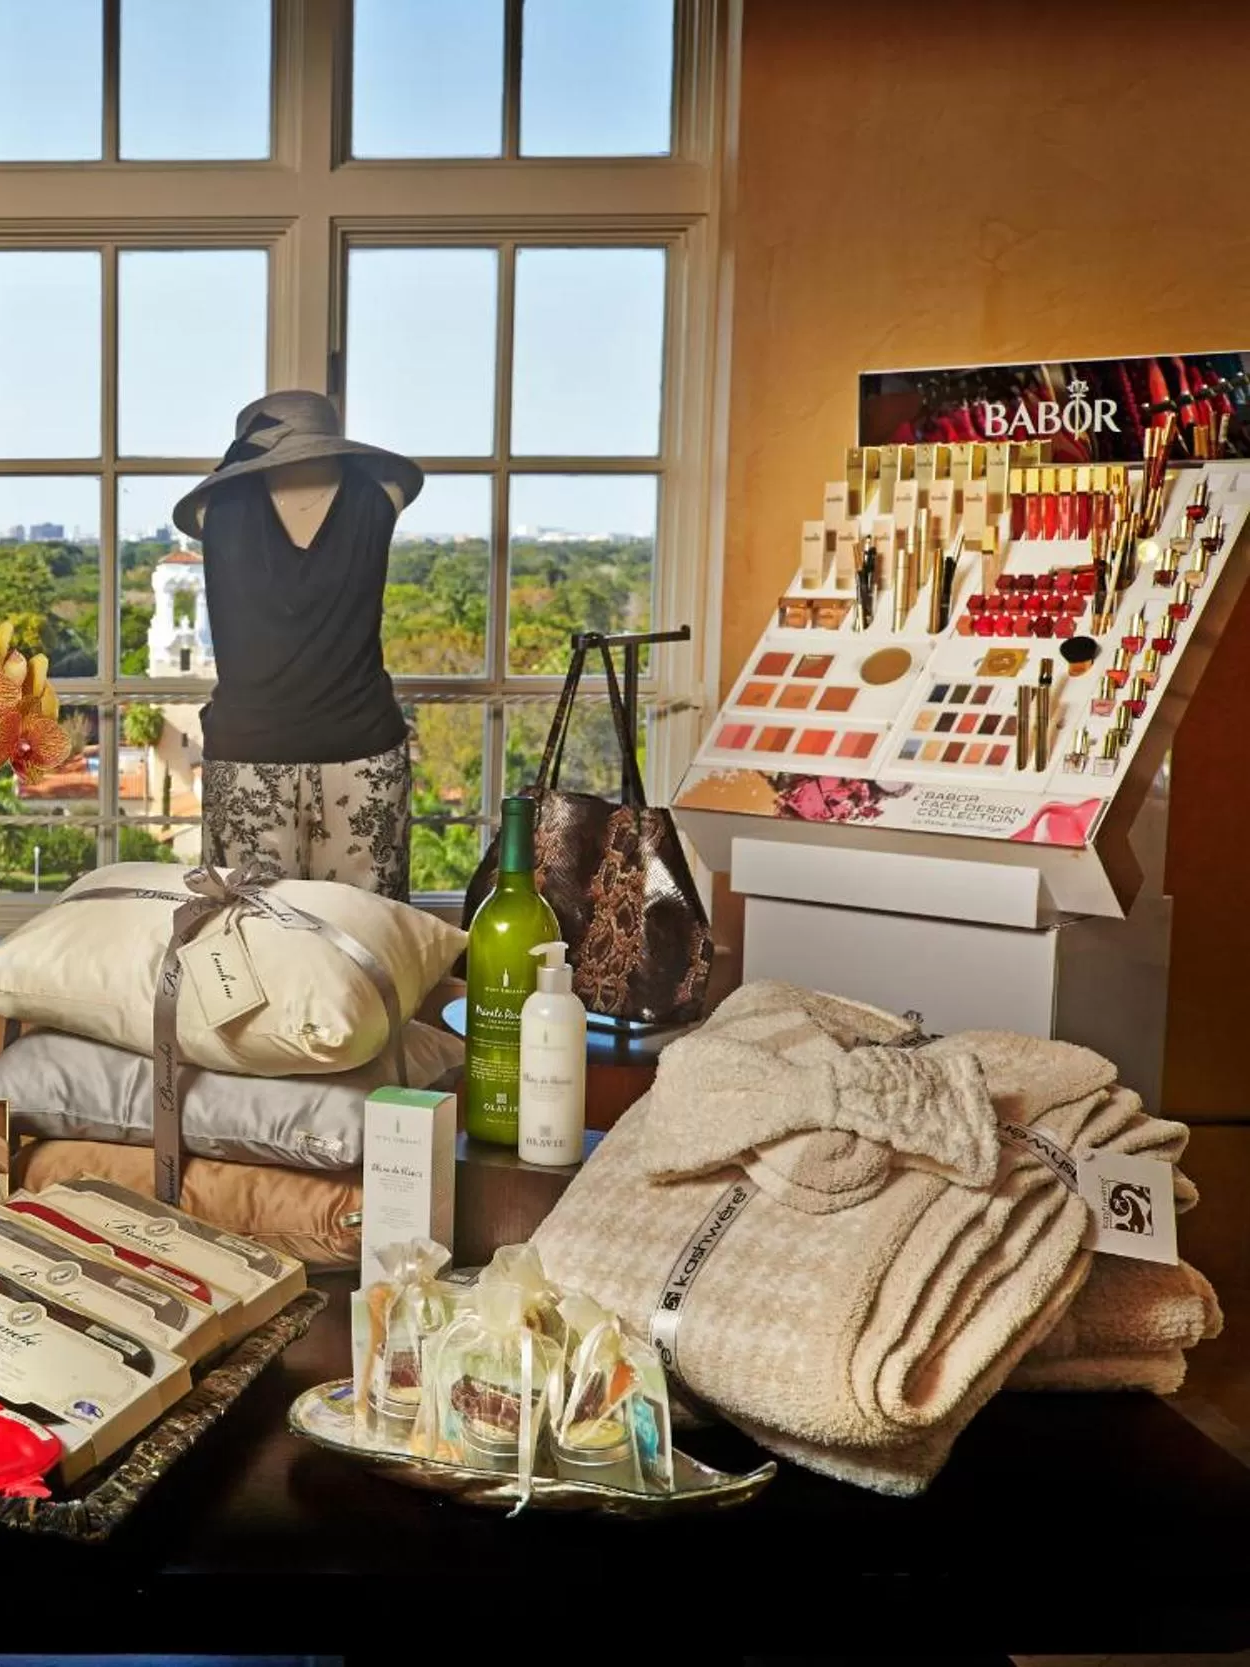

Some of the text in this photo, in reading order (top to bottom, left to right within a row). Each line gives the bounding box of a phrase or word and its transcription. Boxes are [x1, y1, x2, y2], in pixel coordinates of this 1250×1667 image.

[985, 393, 1122, 440] BABOR
[916, 808, 1016, 824] COLLECTION
[920, 800, 1026, 816] FACE DESIGN
